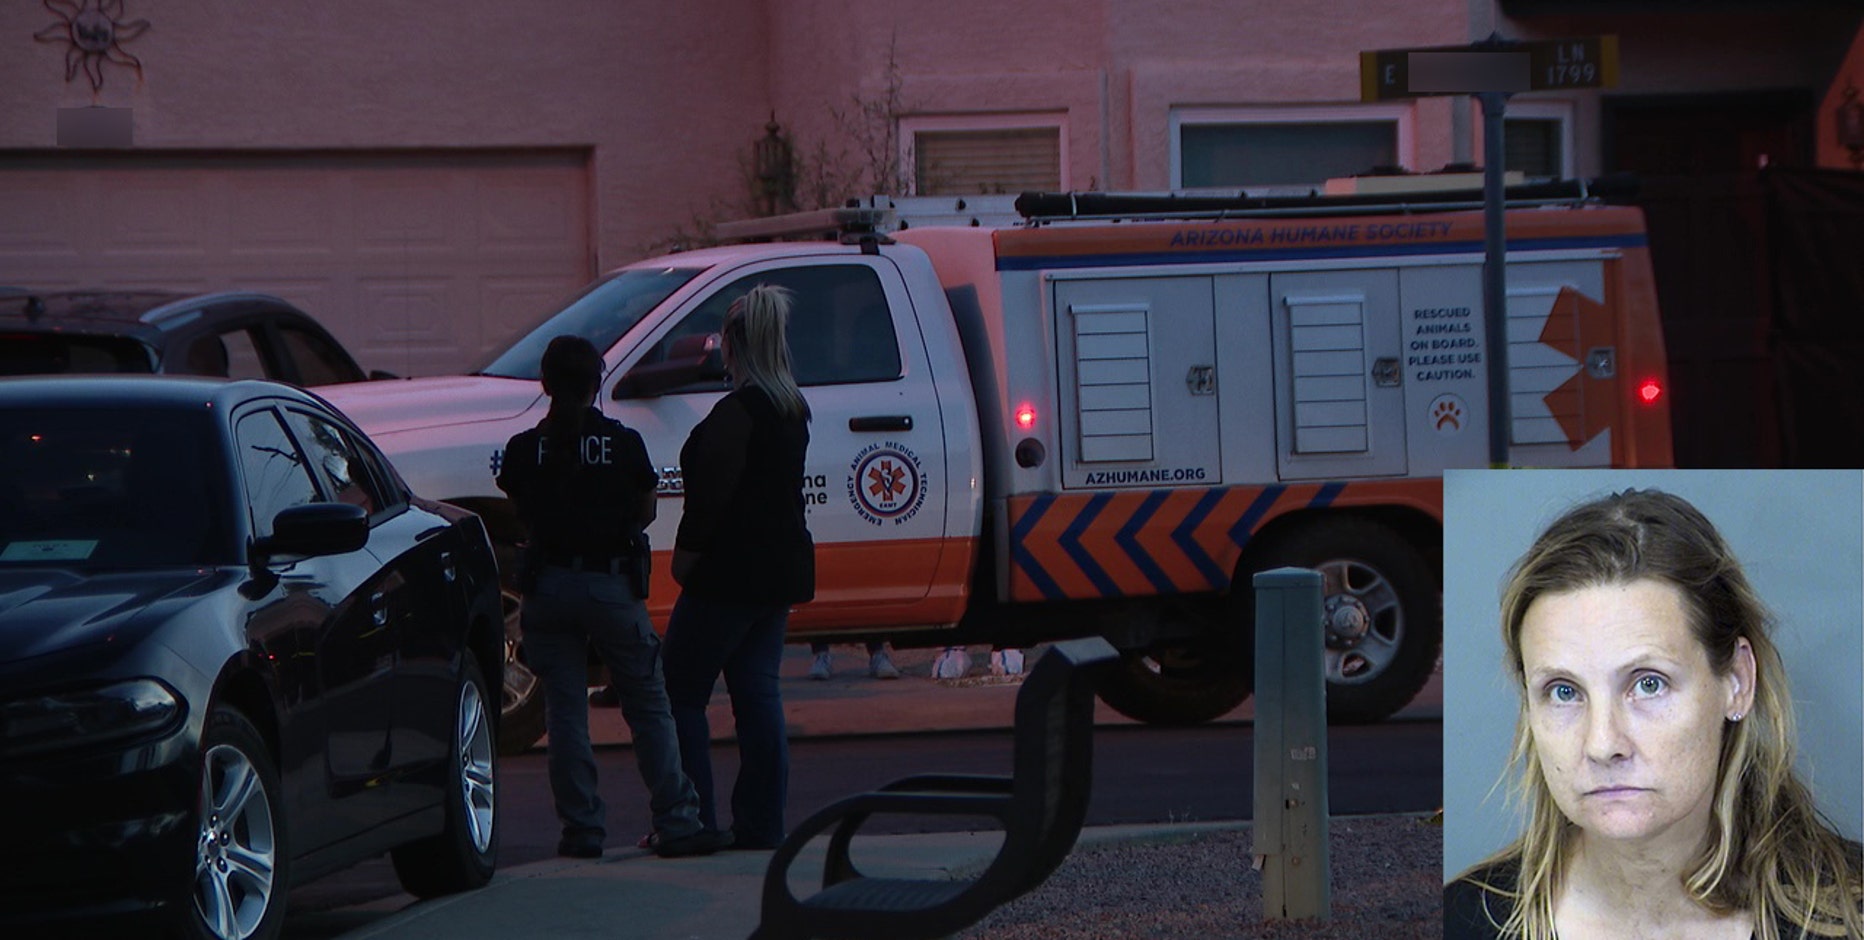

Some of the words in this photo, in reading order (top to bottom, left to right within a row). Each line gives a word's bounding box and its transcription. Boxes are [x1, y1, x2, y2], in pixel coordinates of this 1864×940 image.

[1557, 44, 1585, 63] LN
[1384, 64, 1396, 85] E
[1546, 63, 1596, 85] 1799
[1170, 228, 1265, 247] ARIZONA
[1270, 225, 1359, 242] HUMANE
[1365, 221, 1454, 240] SOCIETY
[1414, 307, 1471, 319] RESCUED
[1416, 323, 1471, 334] ANIMALS
[1410, 341, 1429, 350] ON
[1432, 338, 1479, 350] BOARD.
[1408, 354, 1456, 366] PLEASE
[1458, 353, 1481, 363] USE
[1416, 369, 1476, 381] CAUTION.
[537, 435, 613, 465] PICE
[851, 443, 880, 471] ANIMAL
[885, 441, 921, 469] MEDICAL
[1085, 467, 1206, 485] AZHUMANE.ORG
[847, 475, 883, 526] EMERGENCY
[895, 472, 928, 526] TECHNICIAN
